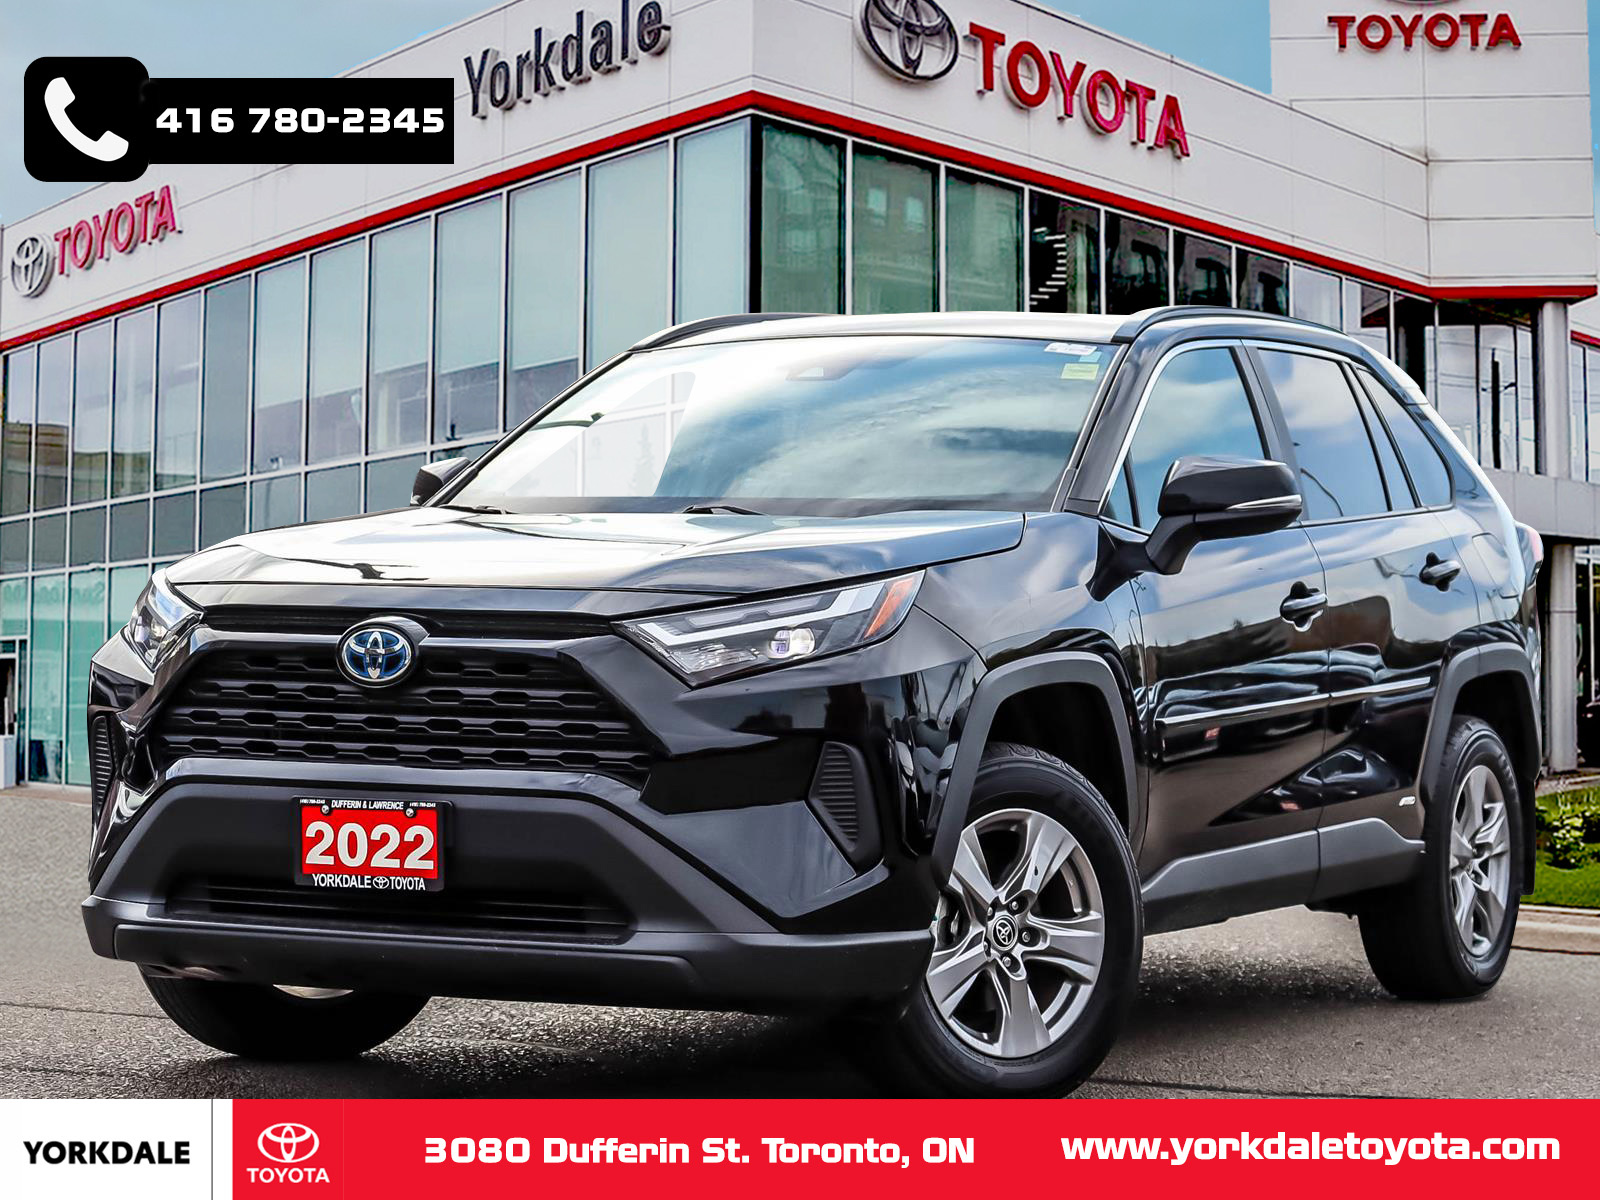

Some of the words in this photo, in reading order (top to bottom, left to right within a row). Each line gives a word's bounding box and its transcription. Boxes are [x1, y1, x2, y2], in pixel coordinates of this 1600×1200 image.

[1327, 13, 1522, 50] TOYOTA
[463, 0, 668, 119] Yorkdale
[965, 21, 1190, 158] TOYOTA
[54, 185, 178, 276] TOYOTA
[331, 800, 361, 809] DUFFERIN
[363, 801, 367, 809] &
[369, 800, 403, 810] LAWRENCE
[305, 820, 435, 870] 2022
[312, 873, 371, 889] YORKDALE
[390, 876, 426, 891] TOYOTA
